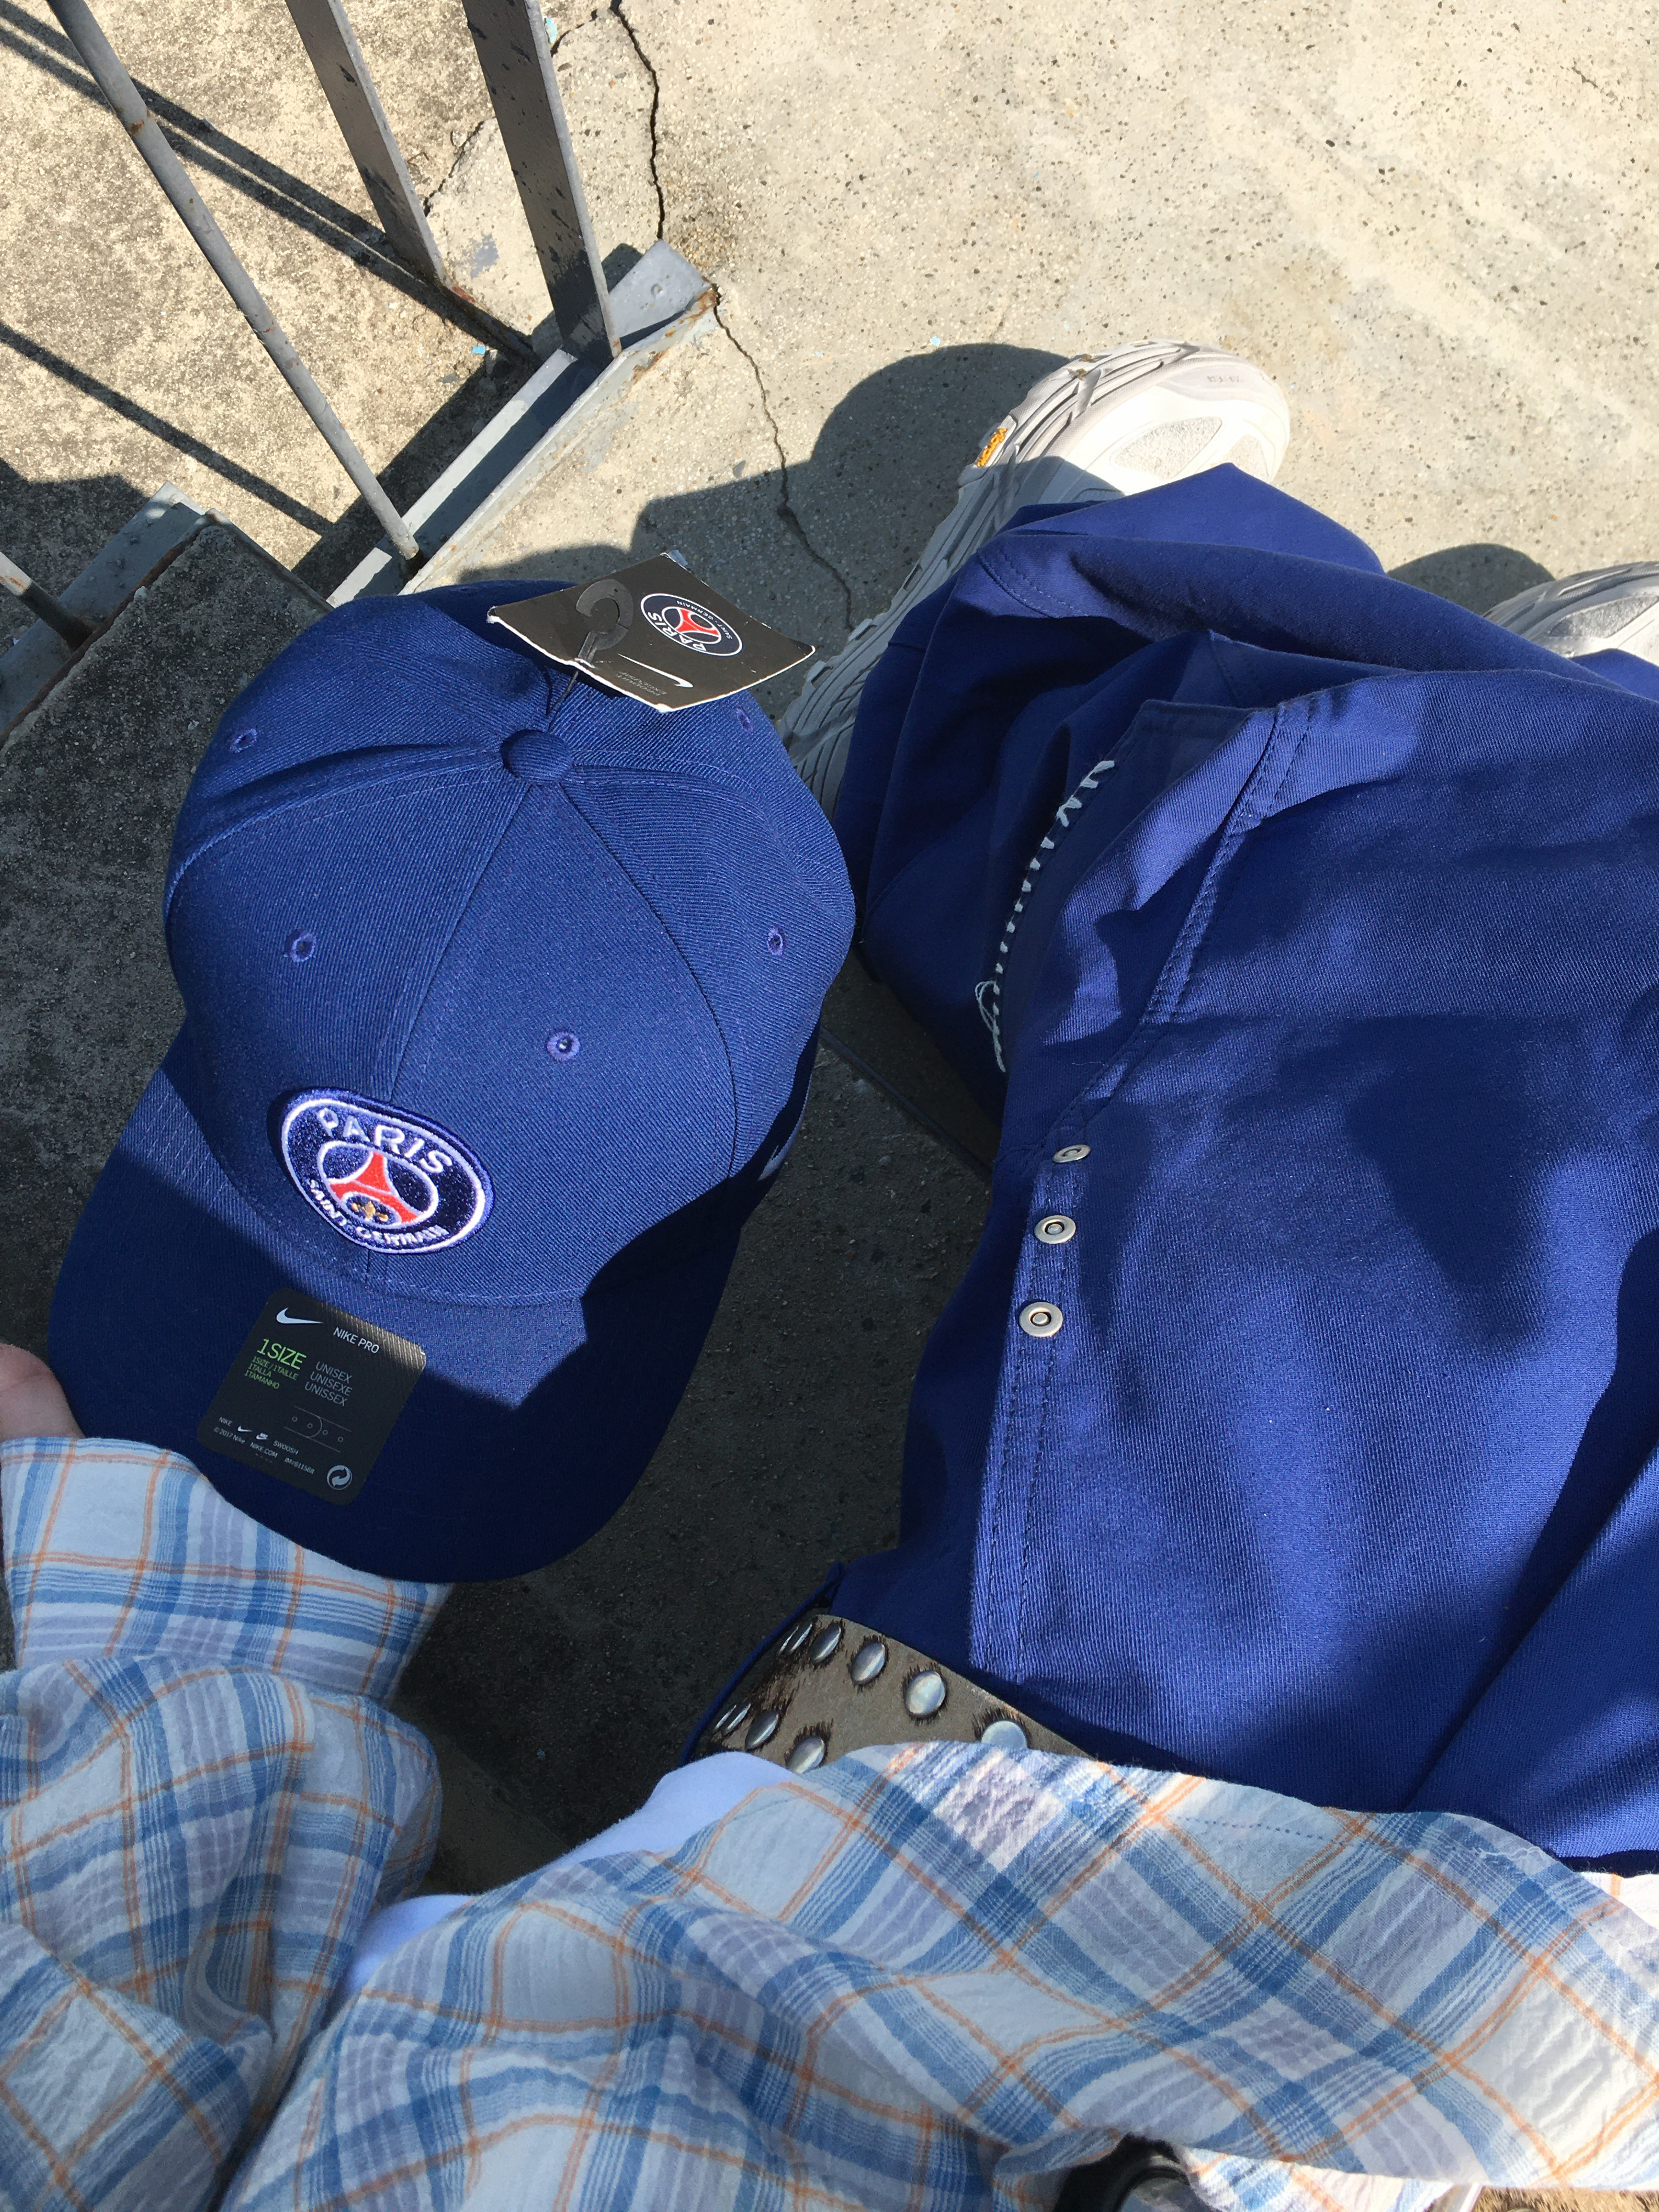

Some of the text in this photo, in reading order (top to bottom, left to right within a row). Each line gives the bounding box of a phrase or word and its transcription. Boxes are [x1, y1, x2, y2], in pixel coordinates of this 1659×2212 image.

[676, 600, 714, 620] GERMAIN
[647, 612, 707, 651] PARIS
[317, 1107, 453, 1173] PARIS
[332, 1327, 380, 1353] NIKE PRO
[257, 1339, 307, 1370] 1SIZE
[245, 1370, 280, 1390] 1TAMANHO
[310, 1371, 353, 1397] UNISEXE
[315, 1361, 353, 1384] UNISEX
[304, 1381, 348, 1407] UNISSEX
[273, 1440, 299, 1455] SWOOSH
